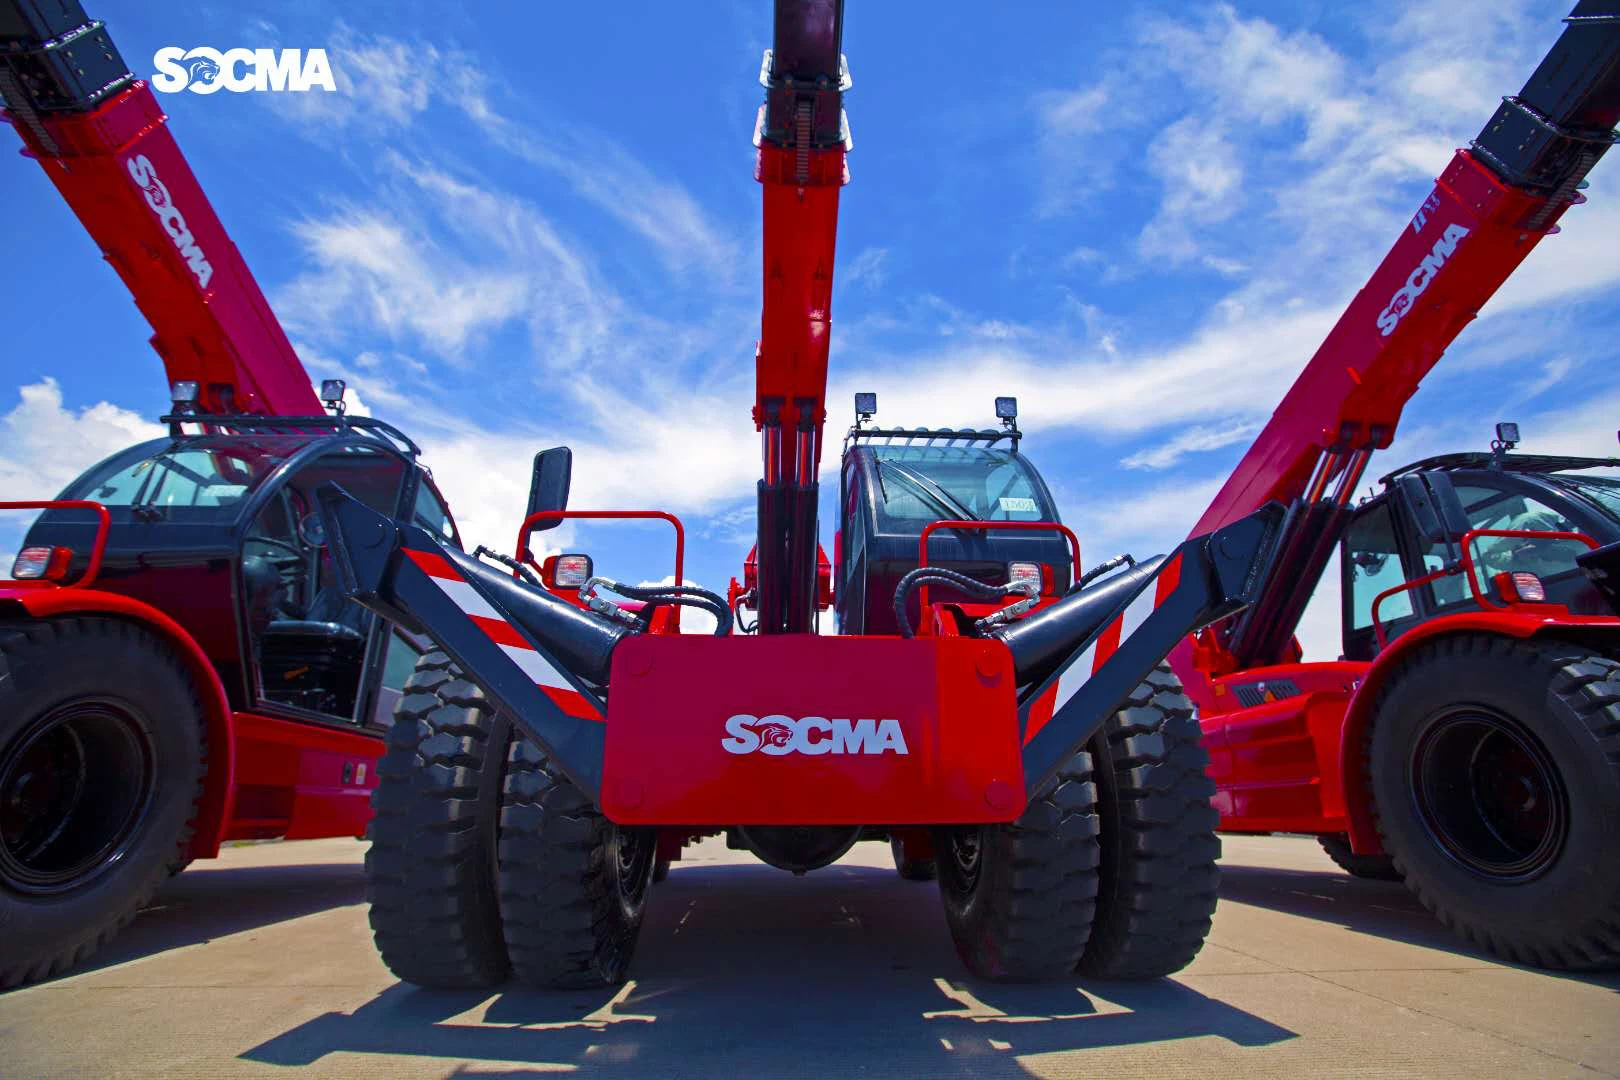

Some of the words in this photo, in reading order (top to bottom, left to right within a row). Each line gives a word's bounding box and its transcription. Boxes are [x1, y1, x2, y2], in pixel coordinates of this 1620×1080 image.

[127, 154, 214, 289] SOCMA
[1376, 223, 1470, 337] SOCMA
[721, 714, 909, 756] SOCMA
